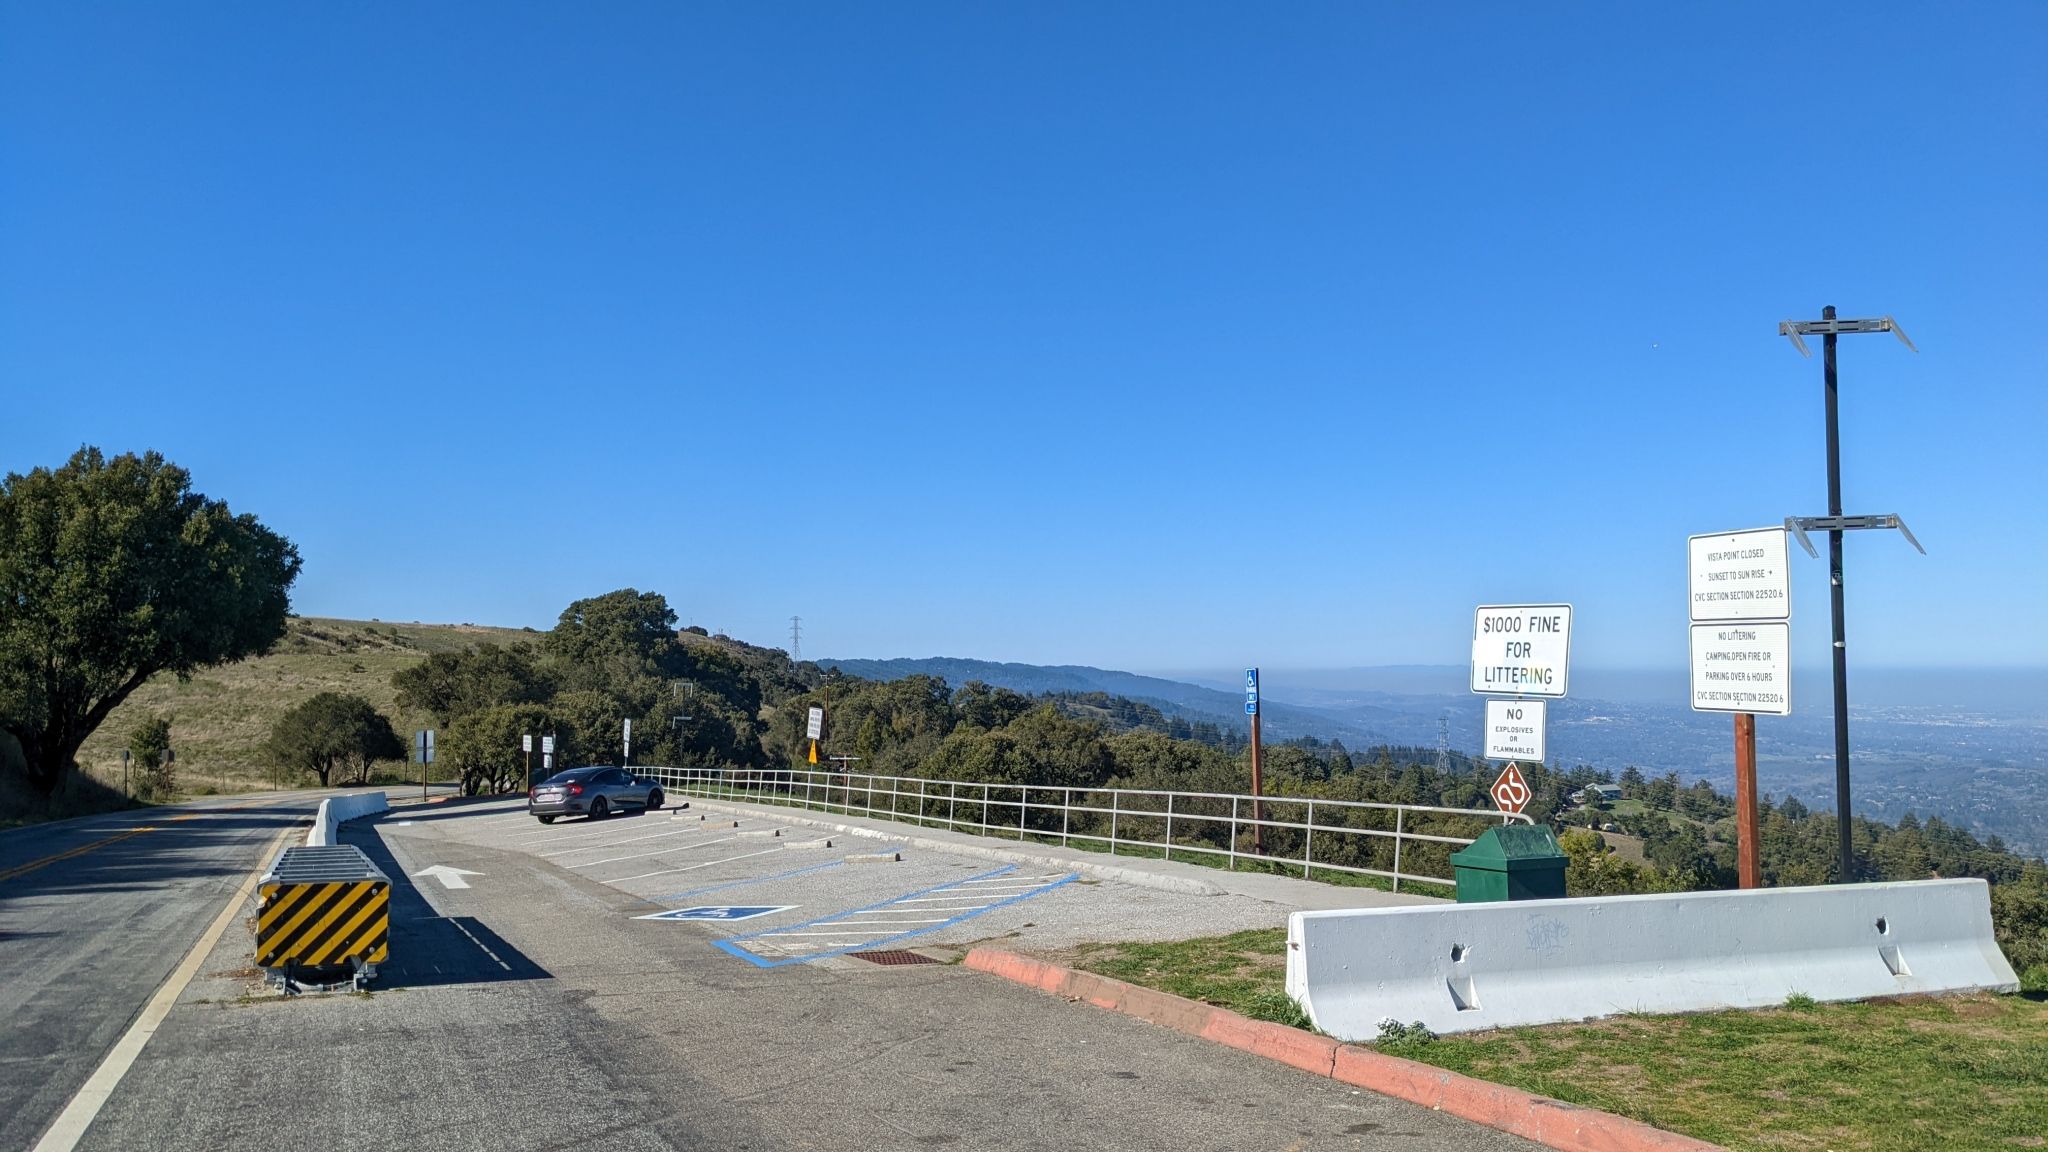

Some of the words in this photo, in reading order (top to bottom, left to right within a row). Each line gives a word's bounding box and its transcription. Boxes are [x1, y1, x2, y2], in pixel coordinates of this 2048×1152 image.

[1708, 553, 1722, 561] VISTA
[1724, 551, 1740, 560] POINT
[1741, 549, 1764, 558] CLOSED
[1708, 572, 1728, 581] SUNSET
[1738, 571, 1749, 579] SUN
[1751, 569, 1765, 578] RISE
[1695, 593, 1705, 601] CVC
[1707, 592, 1728, 601] SECTION
[1730, 591, 1754, 600] SECTION
[1484, 616, 1521, 634] $1000
[1529, 616, 1560, 632] FINE
[1719, 632, 1726, 640] NO
[1728, 631, 1756, 640] LITTERING
[1506, 642, 1531, 658] FOR
[1748, 652, 1761, 660] FIRE
[1485, 667, 1552, 684] LITTERING
[1706, 672, 1729, 680] PARKING
[1731, 672, 1745, 681] OVER
[1752, 673, 1772, 681] HOURS
[1697, 691, 1707, 700] CVC
[1709, 691, 1731, 700] SECTION
[1733, 692, 1756, 702] SECTION
[1507, 709, 1522, 720] NO
[1493, 746, 1534, 754] FLAMMABLES
